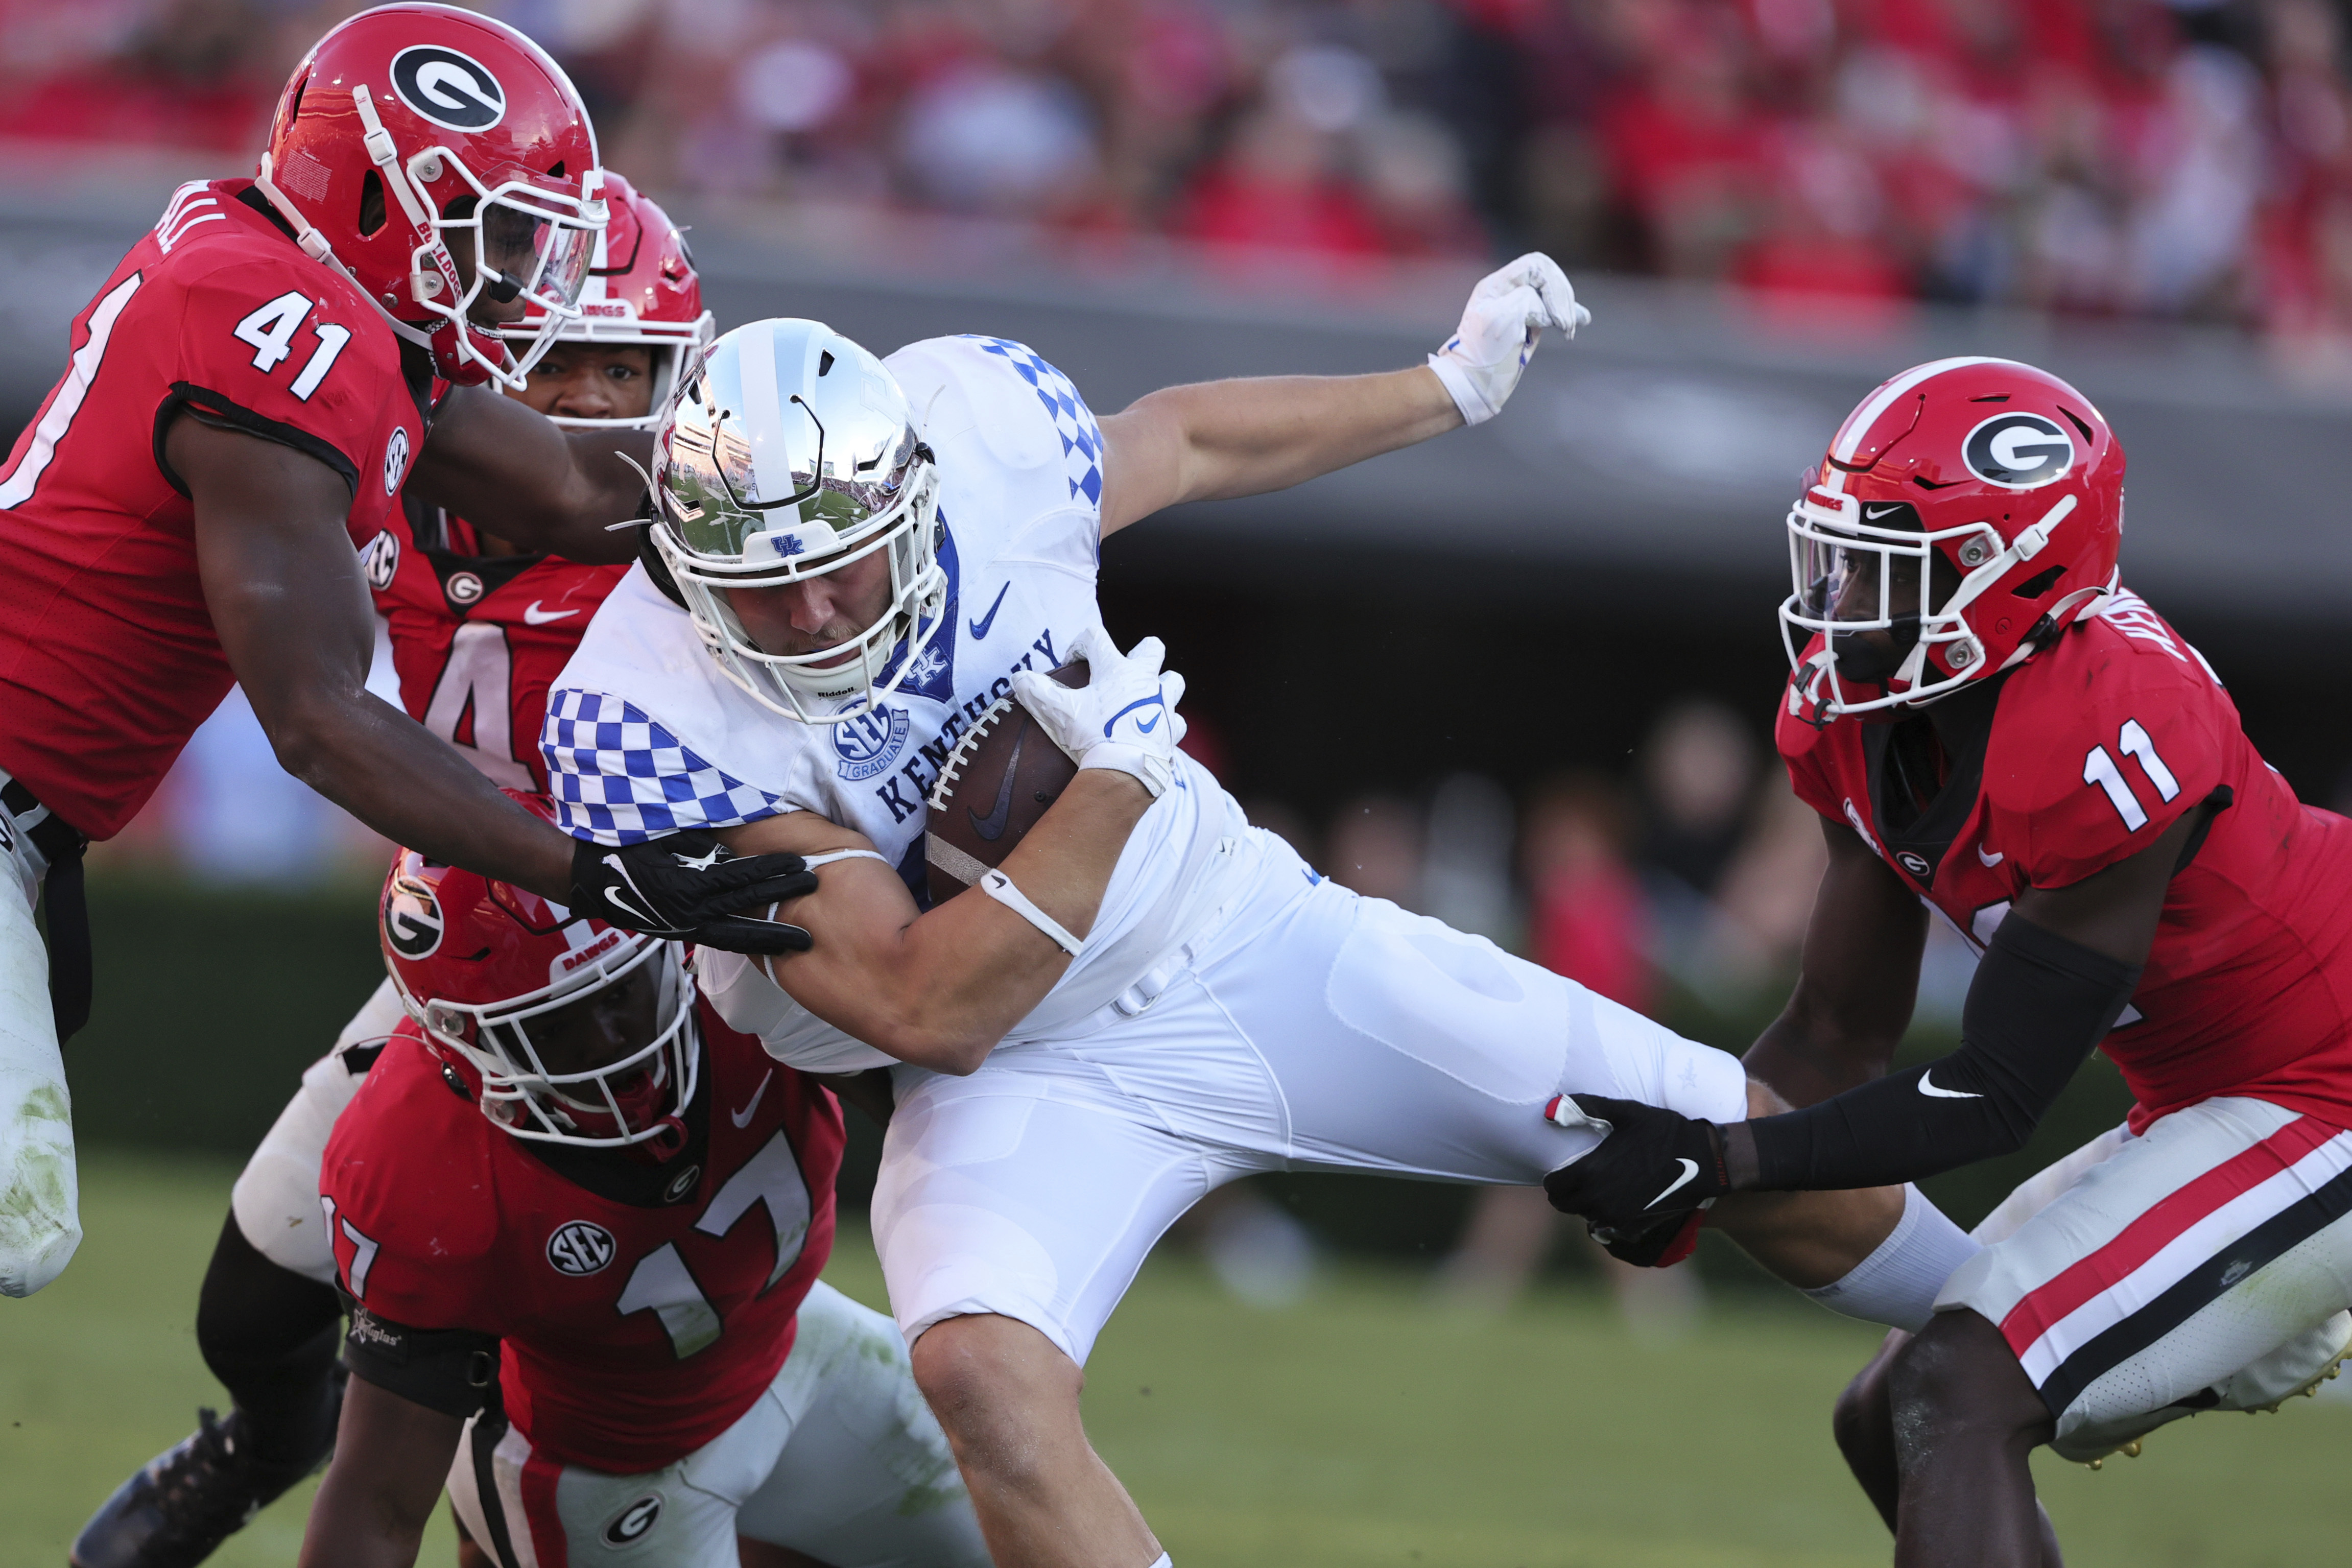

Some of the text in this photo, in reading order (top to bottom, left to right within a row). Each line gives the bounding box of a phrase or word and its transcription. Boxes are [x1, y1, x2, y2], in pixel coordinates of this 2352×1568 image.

[581, 305, 625, 317] WGS
[232, 290, 353, 402] 41
[423, 621, 541, 793] 4
[818, 686, 854, 697] Riddell
[852, 727, 906, 778] GRADUATE
[2082, 718, 2181, 834] 11
[562, 931, 620, 971] DAWGS
[553, 1226, 610, 1273] SEC
[616, 1125, 813, 1360] 17
